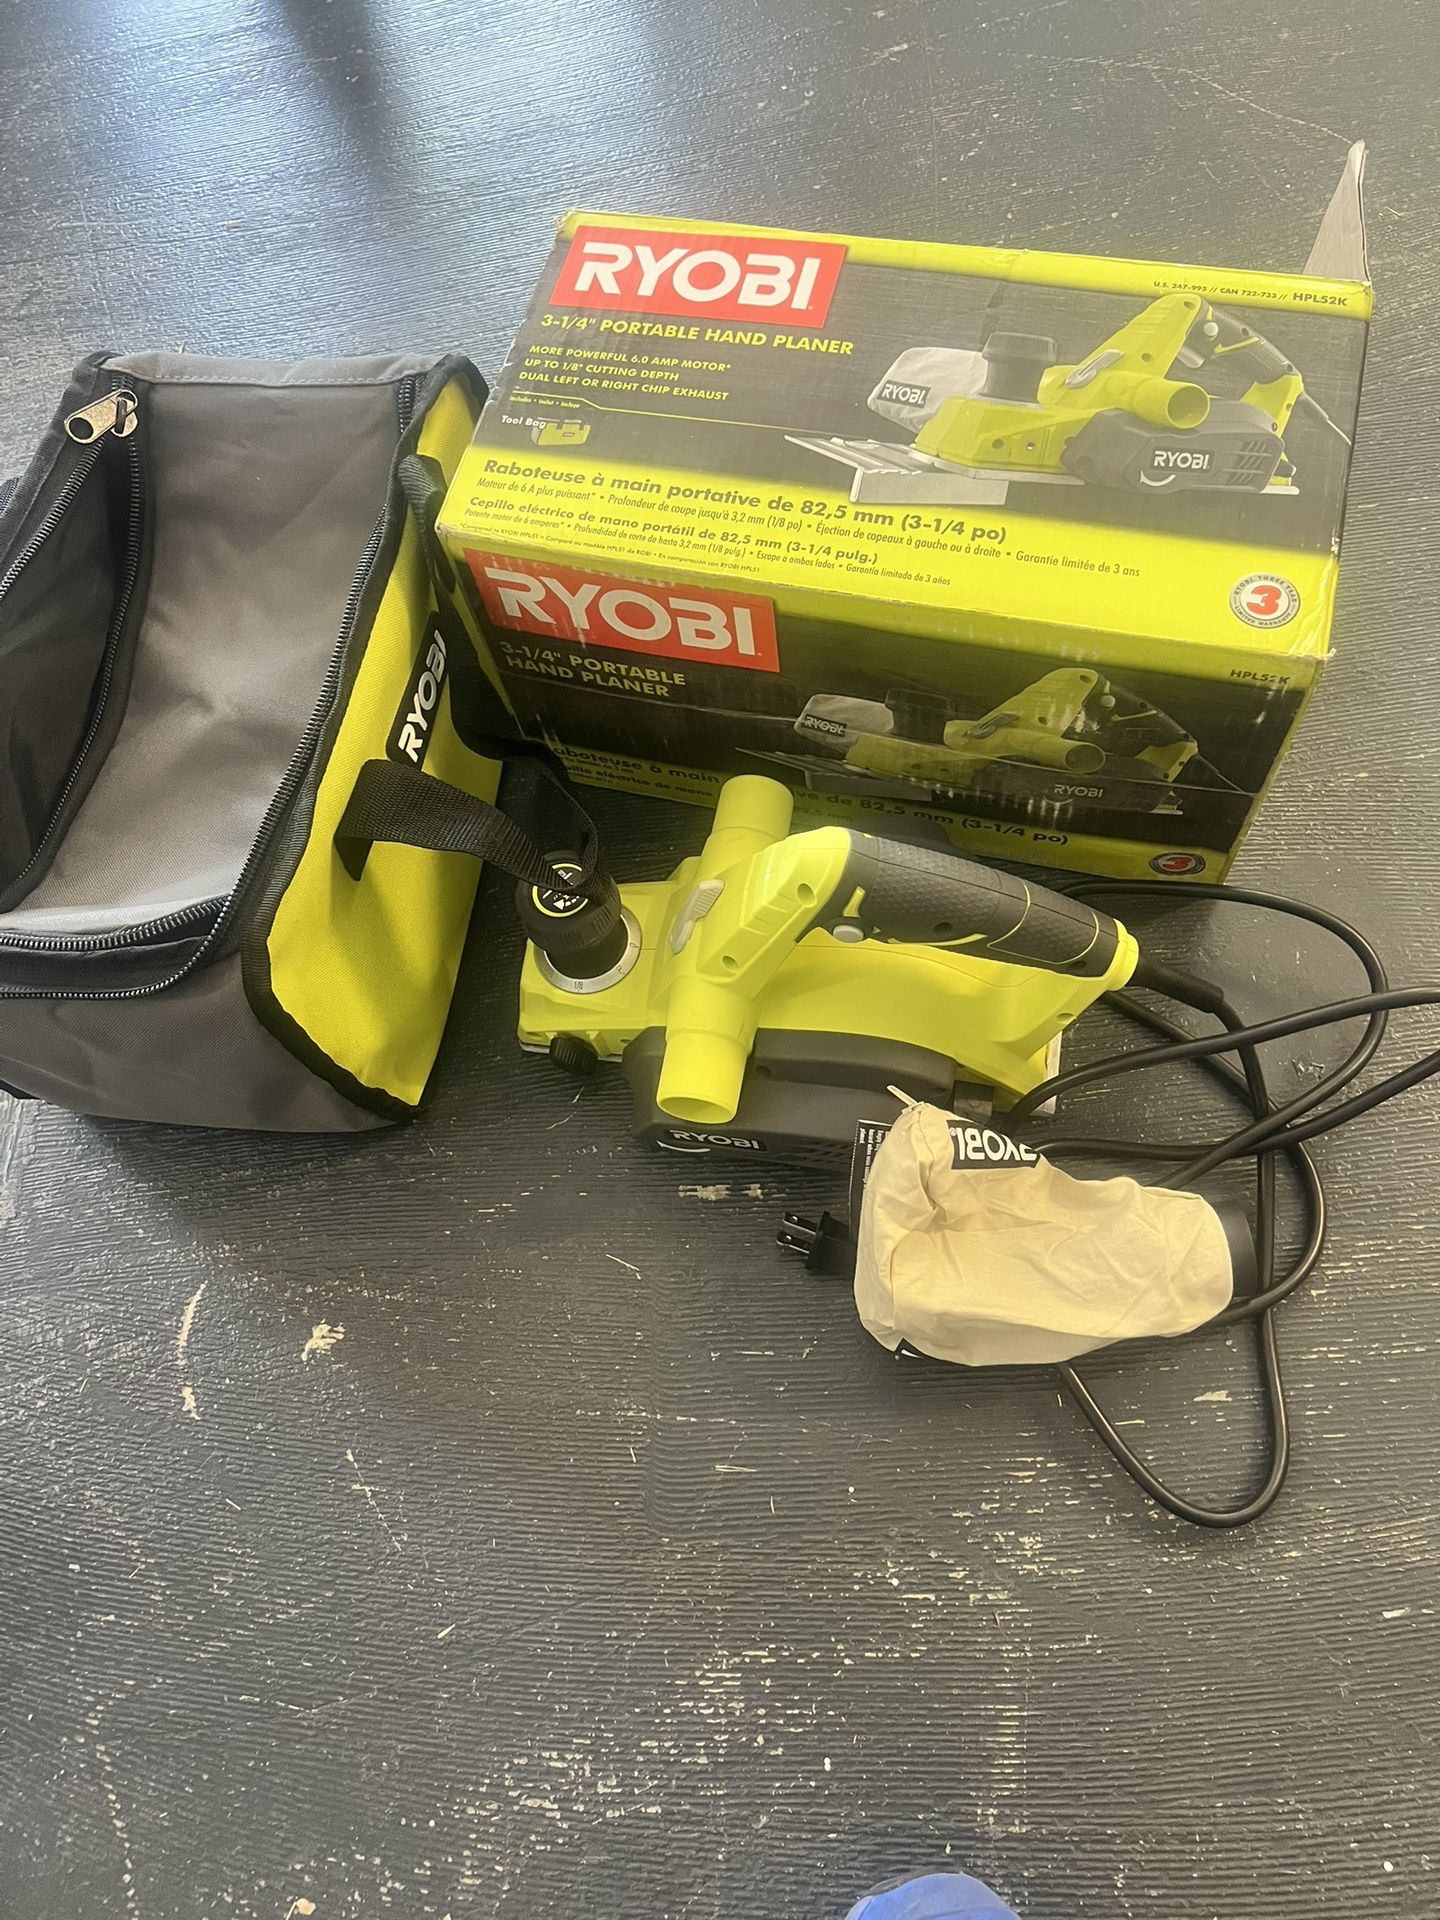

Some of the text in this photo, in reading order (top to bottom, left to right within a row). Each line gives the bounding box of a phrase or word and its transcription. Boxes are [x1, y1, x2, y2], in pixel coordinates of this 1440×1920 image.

[574, 241, 821, 310] RYOBI
[1220, 287, 1239, 295] CAN
[1292, 292, 1348, 306] HPL52K
[541, 314, 854, 355] 3-1/4" PORTABLE HAND PLANER
[524, 358, 542, 367] UP
[544, 360, 559, 369] TO
[585, 363, 638, 377] CUTTING
[640, 370, 679, 382] DEPTH
[529, 345, 564, 356] MORE
[565, 348, 628, 362] POWERFUL
[631, 354, 649, 364] 6.0
[650, 356, 679, 367] AMP
[519, 371, 729, 401] DUAL LEFT OR RIGHT CHIP EXHAUST
[881, 383, 926, 404] RYOBI
[501, 415, 547, 430] Tool Bag
[1153, 450, 1210, 470] RYOBI
[484, 459, 1007, 545] Raboteuse à main portative de 82,5 mm (3-1/4 po)
[470, 496, 878, 565] Cepillo eléctrico de mano portátil de 82,5 mm (3-1/4 pulg.)
[477, 477, 506, 490] Moteur
[508, 482, 519, 492] de
[521, 484, 527, 492] 6
[528, 484, 535, 493] A
[536, 486, 554, 497] plus
[608, 494, 656, 510] Profondeur
[658, 501, 669, 512] de
[671, 504, 697, 517] coupe
[698, 506, 730, 520] jusqu'à
[731, 511, 746, 523] 3,2
[747, 515, 765, 525] mm
[767, 515, 786, 529] (1/8
[787, 519, 803, 532] po)
[816, 520, 851, 537] Éjection
[853, 527, 865, 539] de
[866, 531, 904, 545] copeaux
[906, 534, 913, 546] à
[914, 537, 948, 551] gauche
[950, 543, 962, 553] ou
[965, 543, 971, 554] à
[973, 544, 1001, 558] droite
[1016, 550, 1059, 567] Garantie
[1061, 556, 1095, 571] limitée
[1098, 561, 1110, 573] de
[1113, 563, 1120, 575] 3
[1122, 567, 1141, 577] ans
[513, 514, 522, 524] de
[573, 523, 617, 537] Profundidad
[618, 530, 627, 539] de
[628, 532, 646, 542] corte
[648, 533, 658, 543] de
[658, 535, 678, 546] hasta
[679, 540, 691, 550] 3,2
[692, 543, 706, 551] mm
[756, 551, 781, 562] Escape
[789, 556, 814, 567] ambos
[815, 558, 835, 569] lados
[846, 563, 879, 577] Garantía
[880, 566, 912, 580] limitada
[914, 571, 924, 582] de
[925, 574, 931, 583] 3
[932, 575, 951, 586] años
[484, 566, 756, 657] RYOBI
[1246, 584, 1282, 616] 3
[505, 655, 671, 698] HAND PLANER
[569, 654, 688, 686] PORTABLE
[397, 629, 446, 763] RYOBI
[805, 716, 846, 735] RYOBI
[669, 768, 720, 784] main
[1054, 784, 1103, 798] RYOBI
[860, 800, 906, 816] 82,5
[913, 811, 954, 825] mm
[962, 817, 1025, 836] (3-1/4
[1033, 831, 1069, 846] po)
[669, 1129, 760, 1150] RYOBI
